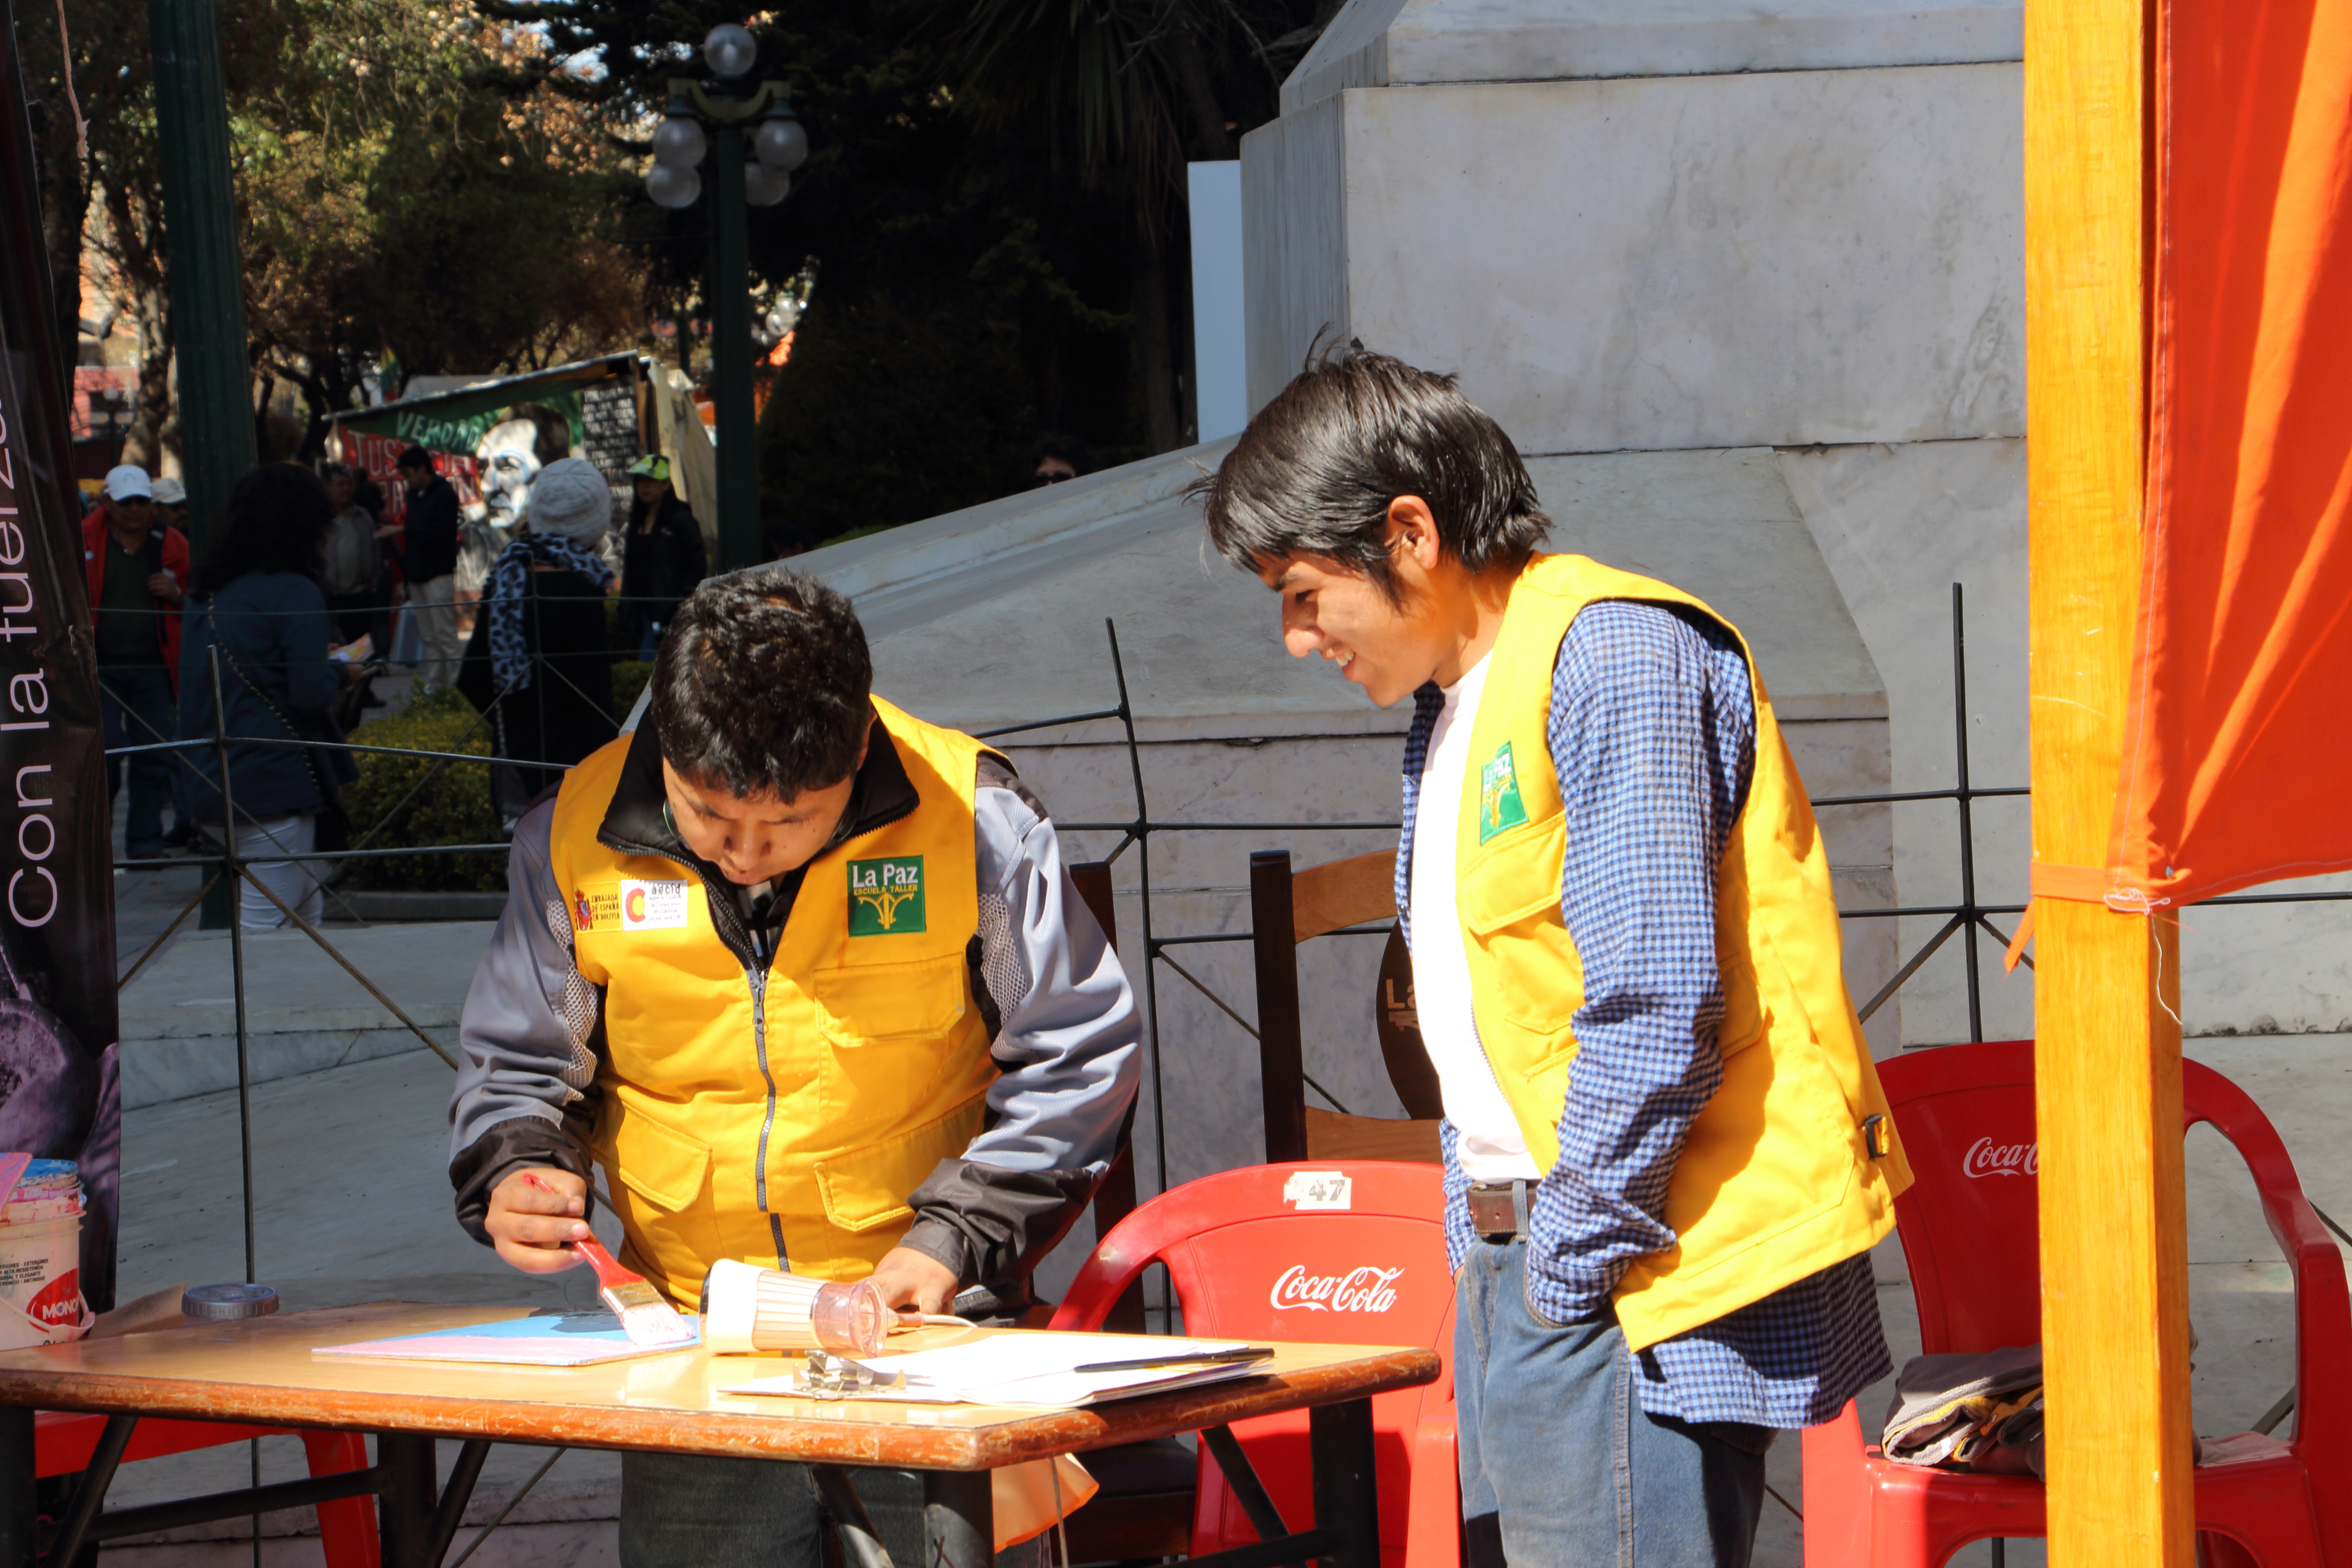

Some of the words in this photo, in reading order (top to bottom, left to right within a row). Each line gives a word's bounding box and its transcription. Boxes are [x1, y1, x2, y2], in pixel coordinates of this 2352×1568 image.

[396, 410, 484, 452] VERDAD
[0, 398, 37, 642] fuer
[0, 668, 49, 731] la
[8, 765, 57, 927] Con
[853, 865, 877, 888] La
[883, 863, 918, 886] Paz
[591, 893, 617, 902] EMBAJADA
[853, 887, 887, 896] ESCUELA
[890, 884, 918, 893] TALLER
[600, 902, 619, 911] ESPAÑA
[601, 912, 620, 921] BOLIVIA
[1963, 1137, 2038, 1178] Coca-C
[1308, 1179, 1346, 1201] 47
[1270, 1264, 1405, 1313] Coca-Cola
[43, 1297, 79, 1320] MONO
